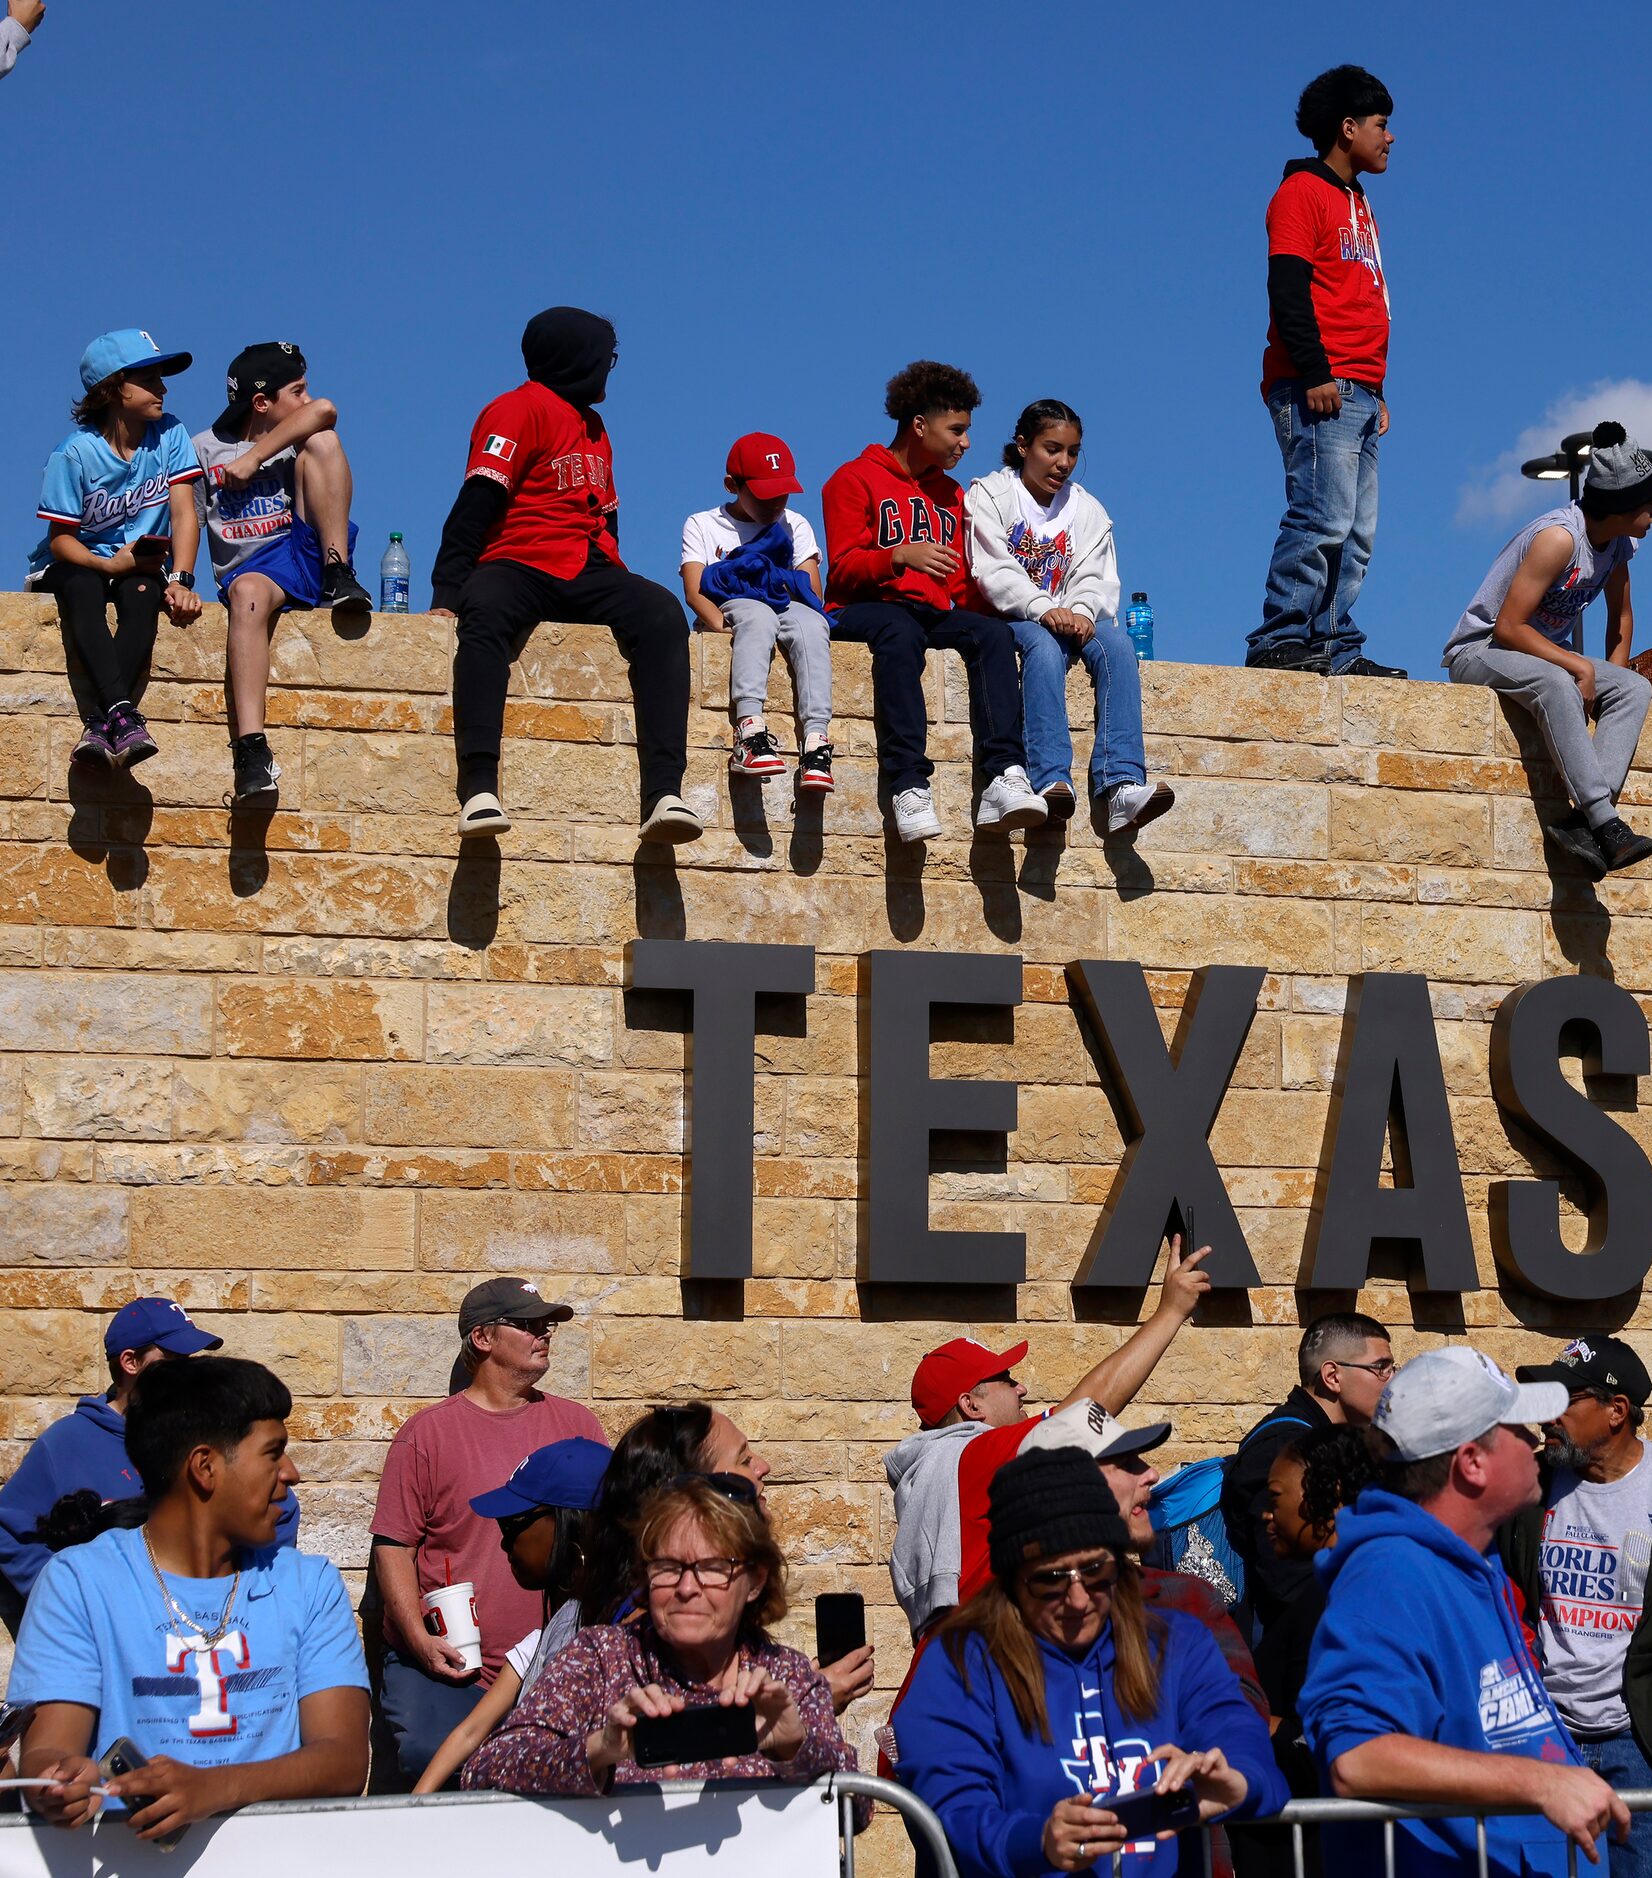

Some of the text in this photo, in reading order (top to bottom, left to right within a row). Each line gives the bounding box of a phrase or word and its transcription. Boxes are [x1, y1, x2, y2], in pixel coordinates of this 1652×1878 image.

[765, 453, 781, 470] T
[878, 497, 957, 549] GAP
[1539, 1568, 1617, 1601] ERIES
[166, 1630, 251, 1738] T
